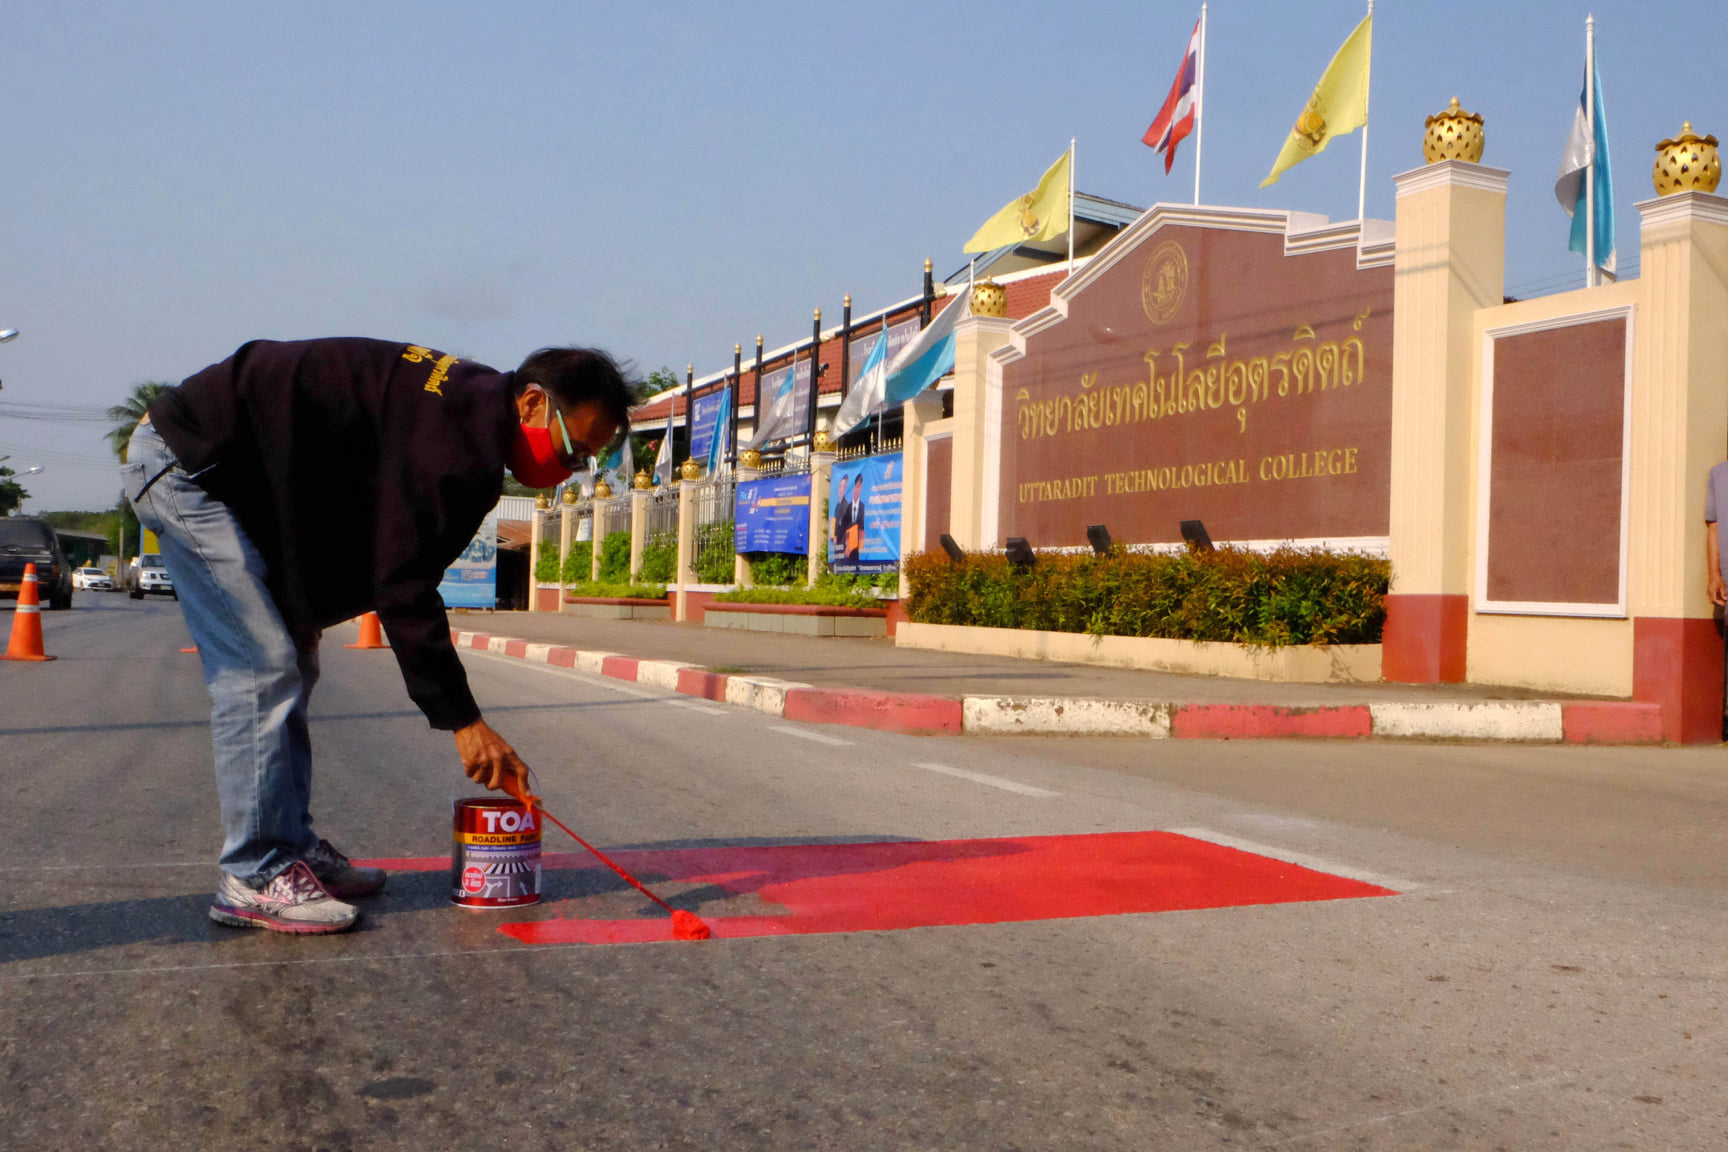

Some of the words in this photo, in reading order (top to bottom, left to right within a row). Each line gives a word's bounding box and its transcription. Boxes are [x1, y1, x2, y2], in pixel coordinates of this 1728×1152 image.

[1017, 305, 1371, 440] วิทยาลัยเทคโนโลยีอุตรดิตถ์
[1019, 477, 1098, 503] UTTARADIT
[1105, 459, 1249, 495] TECHNOLOGICAL
[1260, 448, 1359, 481] COLLEGE
[472, 835, 517, 844] ROADLINE
[482, 811, 535, 833] TOA
